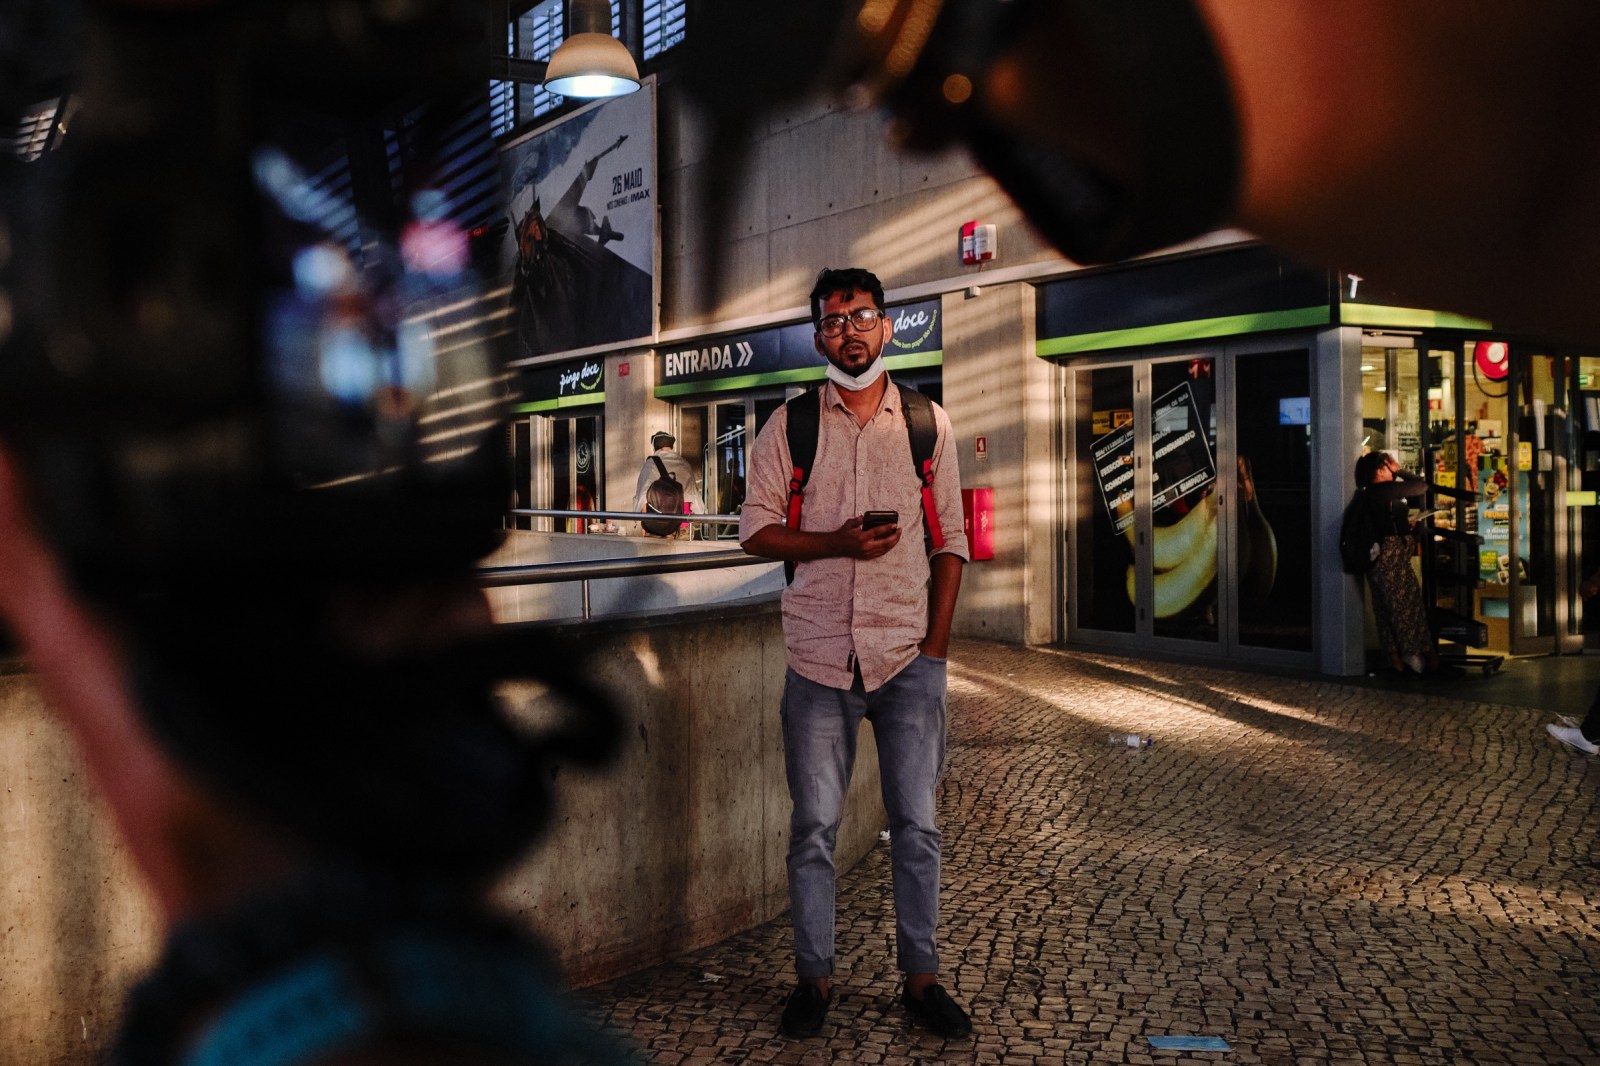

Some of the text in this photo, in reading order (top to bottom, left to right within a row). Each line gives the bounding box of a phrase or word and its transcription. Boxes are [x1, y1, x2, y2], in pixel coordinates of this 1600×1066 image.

[612, 167, 642, 196] 26 MAIO
[630, 188, 650, 203] IMAX
[893, 309, 929, 333] doce
[665, 344, 733, 377] ENTRADA
[560, 369, 580, 395] pingo
[581, 361, 600, 379] doce
[1155, 430, 1196, 460] ATENDIMENTO
[1179, 471, 1208, 492] SIMPATIA
